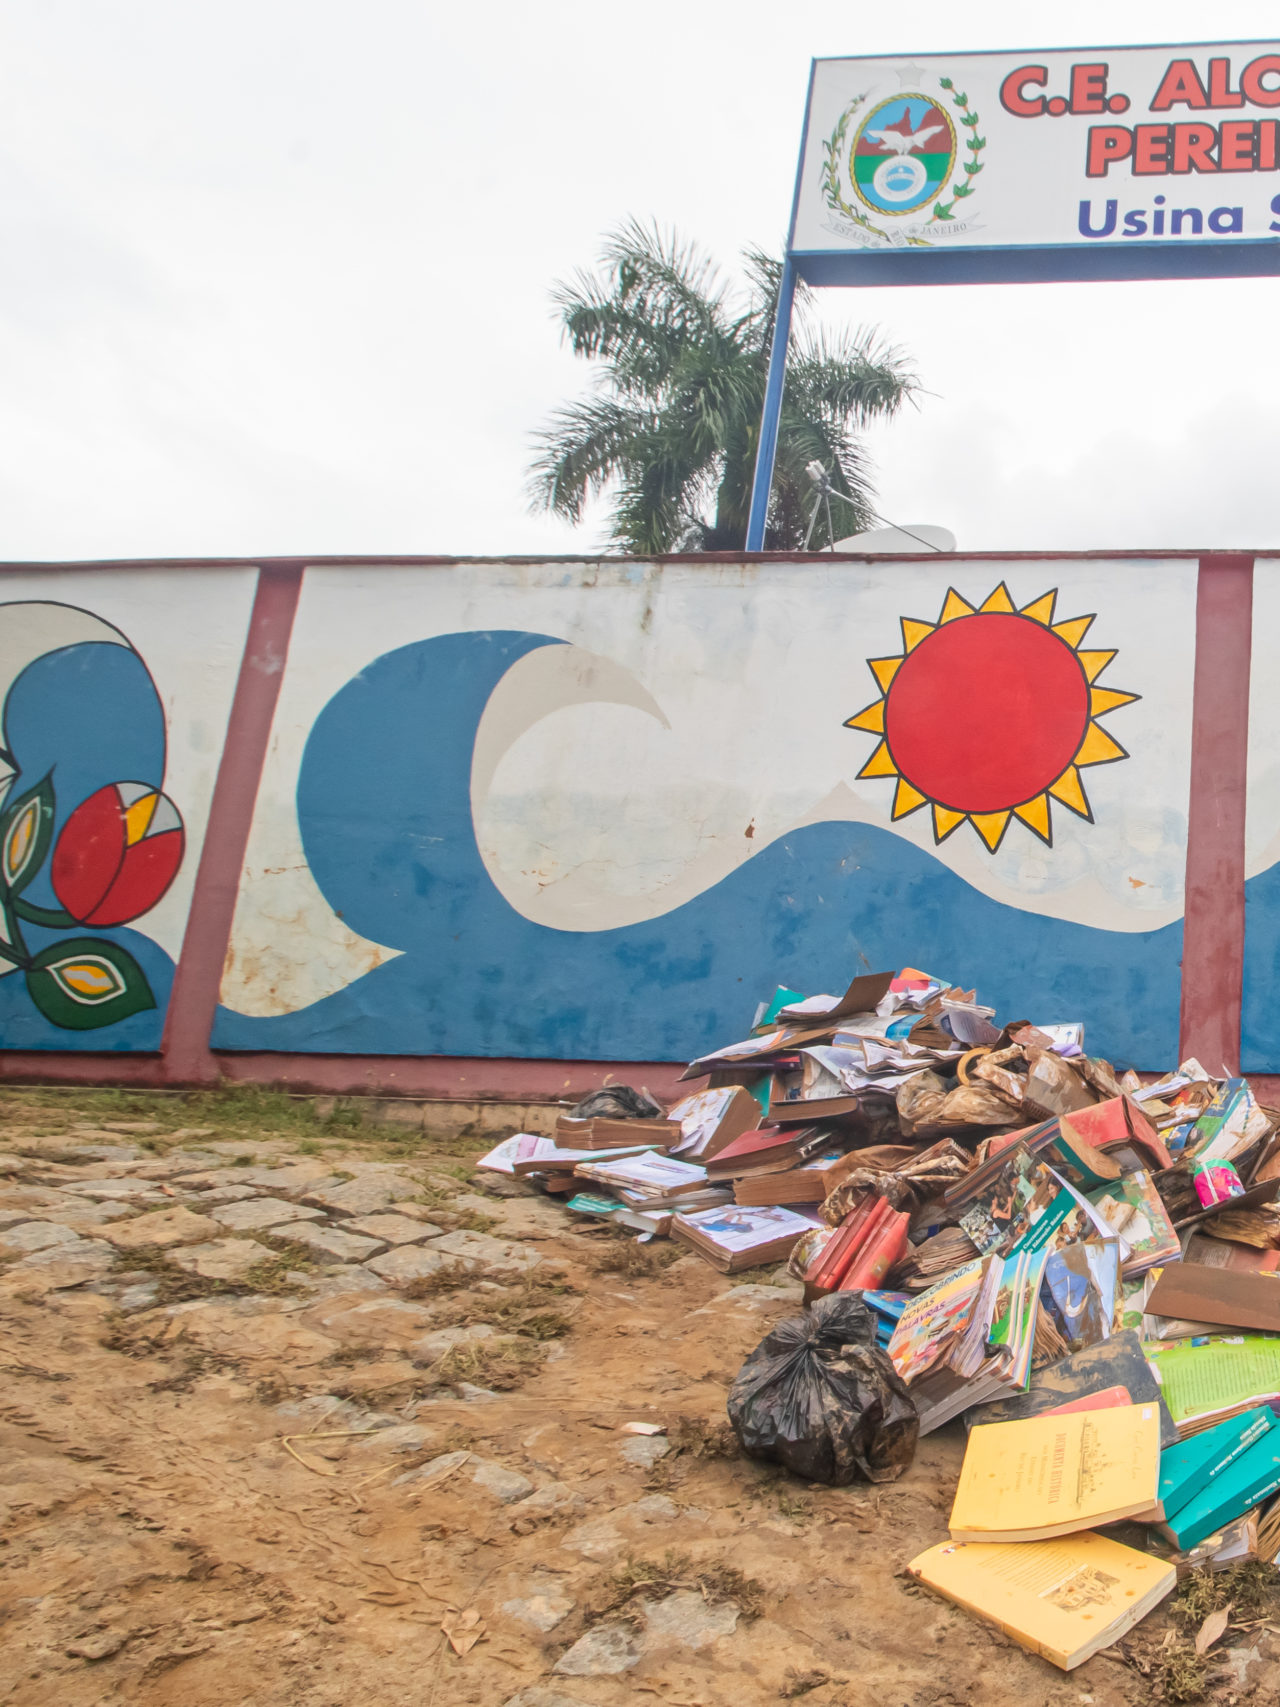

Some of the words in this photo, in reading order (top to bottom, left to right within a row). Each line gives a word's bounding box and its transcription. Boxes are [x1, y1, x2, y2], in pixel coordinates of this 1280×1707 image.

[999, 64, 1131, 118] C.E.
[832, 223, 871, 243] ESTADO
[920, 222, 967, 235] JANEIRO
[1077, 195, 1244, 238] Usina
[906, 1262, 976, 1310] DESCOBRINDO
[895, 1301, 946, 1334] PALAVRAS
[900, 1297, 935, 1323] NOVAS
[1252, 1480, 1278, 1499] Nacionais
